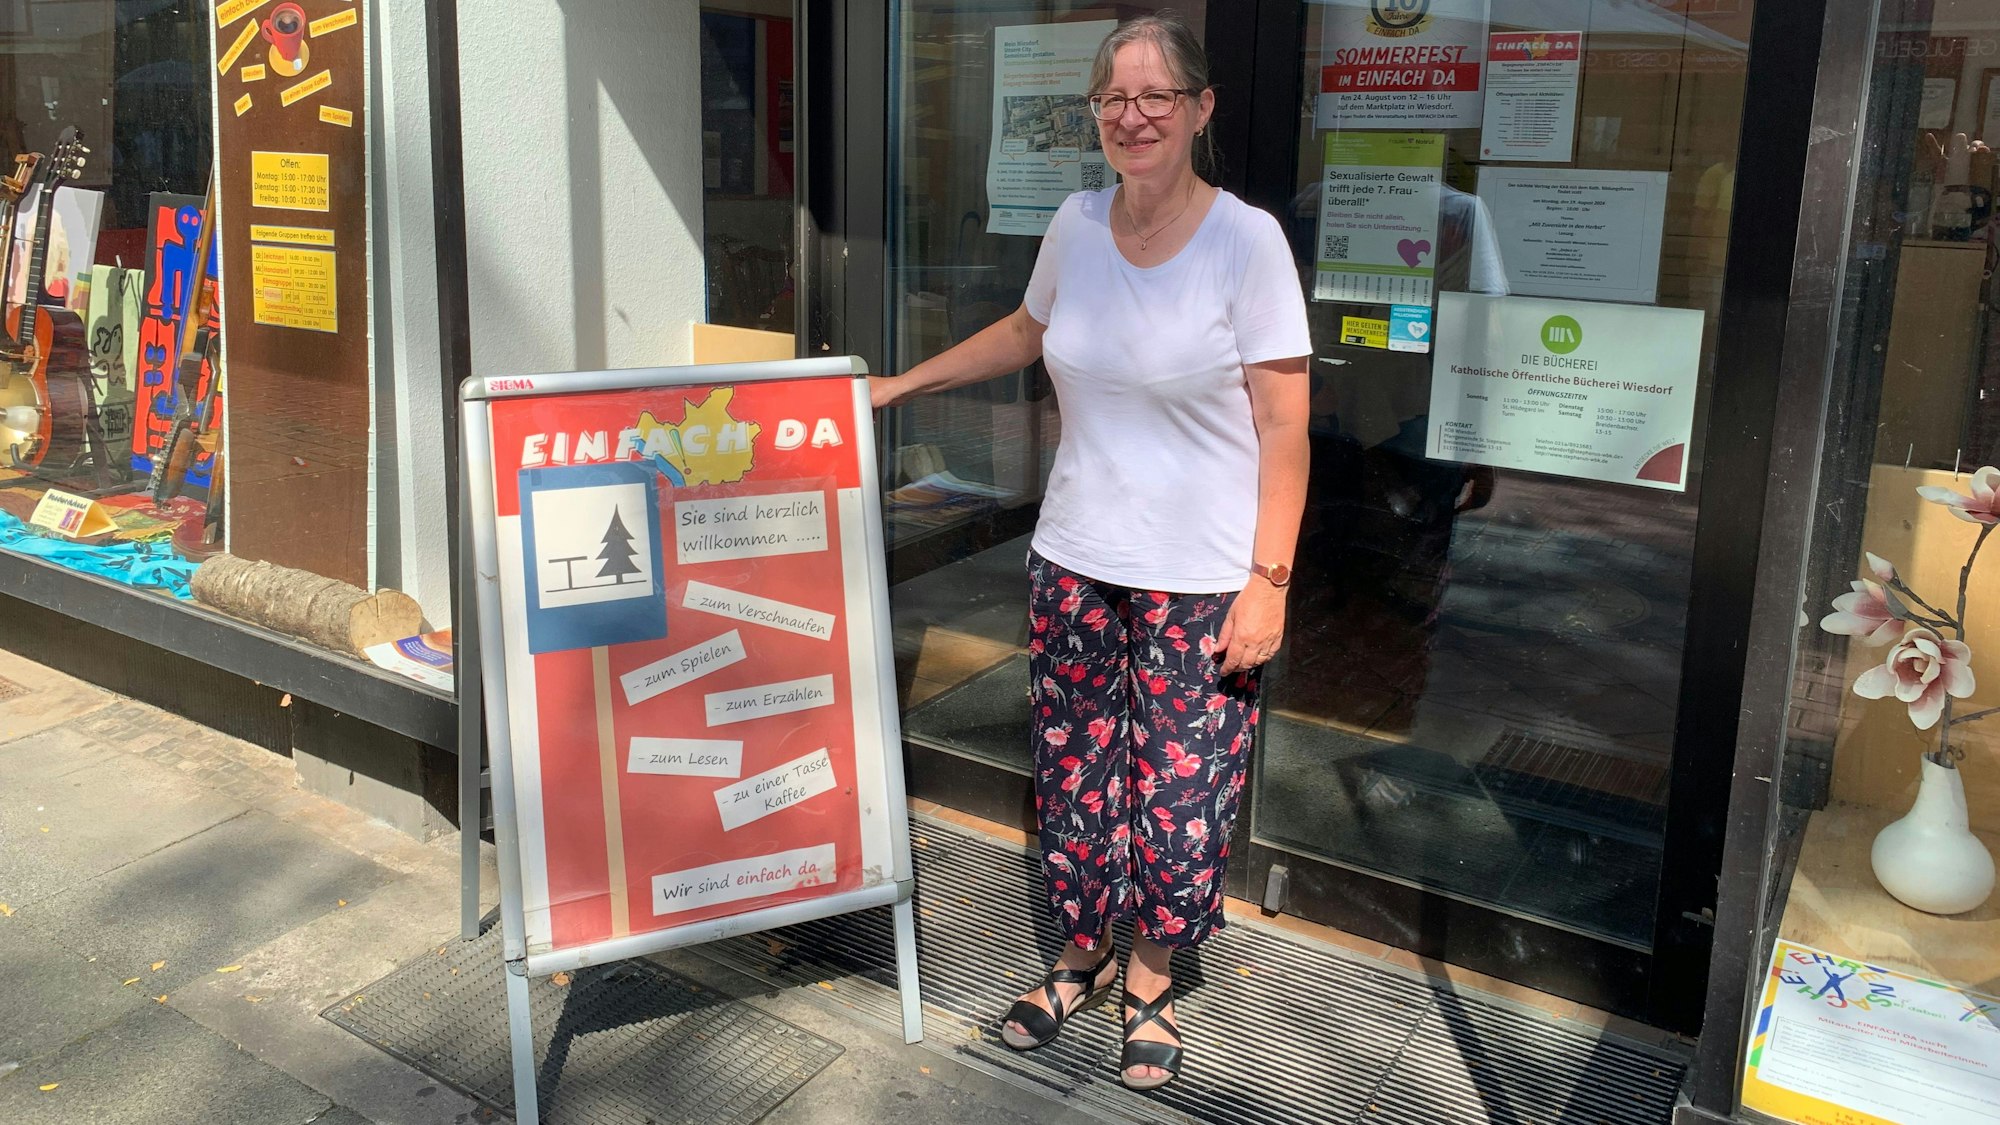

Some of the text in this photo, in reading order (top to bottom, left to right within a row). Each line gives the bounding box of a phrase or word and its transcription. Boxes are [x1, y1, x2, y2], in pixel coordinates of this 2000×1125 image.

[1496, 41, 1574, 51] EINFACH DA
[1334, 46, 1468, 65] SOMMERFEST
[1338, 70, 1456, 86] IM EINFACH DA
[1366, 104, 1405, 112] Marktplatz
[280, 159, 301, 168] Offen:
[257, 172, 279, 181] Montag:
[281, 173, 295, 181] 15:00
[300, 174, 315, 182] 17:00
[1330, 171, 1434, 182] Sexualisierte Gewalt
[255, 183, 279, 192] Dienstag:
[282, 184, 296, 192] 15:00
[301, 185, 315, 193] 17:30
[1329, 184, 1412, 195] trifft jede 7. Frau
[301, 197, 316, 205] 12:00
[1374, 224, 1422, 233] Unterstützung
[279, 231, 299, 239] Gruppen
[1360, 322, 1382, 330] GELTEN
[1521, 354, 1598, 371] DIE BÜCHEREI
[490, 379, 534, 392] SIGMA
[1450, 365, 1673, 395] Katholische Öffentliche Bücherei Wiesdorf
[1466, 393, 1488, 401] Sonntag
[1527, 389, 1588, 401] ÖFFNUNGSZEITEN
[1511, 405, 1535, 414] Hildegard
[1558, 403, 1584, 412] Dienstag
[1558, 410, 1582, 419] Samstag
[1445, 421, 1473, 429] KONTAKT
[520, 417, 843, 468] EINFACH DA
[681, 501, 820, 526] Sie sind herzlich
[682, 531, 788, 553] willkommen
[700, 595, 826, 635] zum Verschnaufen
[644, 644, 732, 688] zum Spielen
[726, 687, 823, 712] zum Erzählen
[649, 752, 728, 766] zum Lesen
[733, 757, 828, 803] zu einer Tasse
[764, 786, 807, 811] Kaffee
[663, 861, 820, 901] Wir sind einfach da.
[1857, 1021, 1947, 1049] EINFACH DA sucht
[1818, 1016, 1875, 1036] Mitarbeiter
[1900, 1040, 1988, 1068] Mitarbeiterinnen
